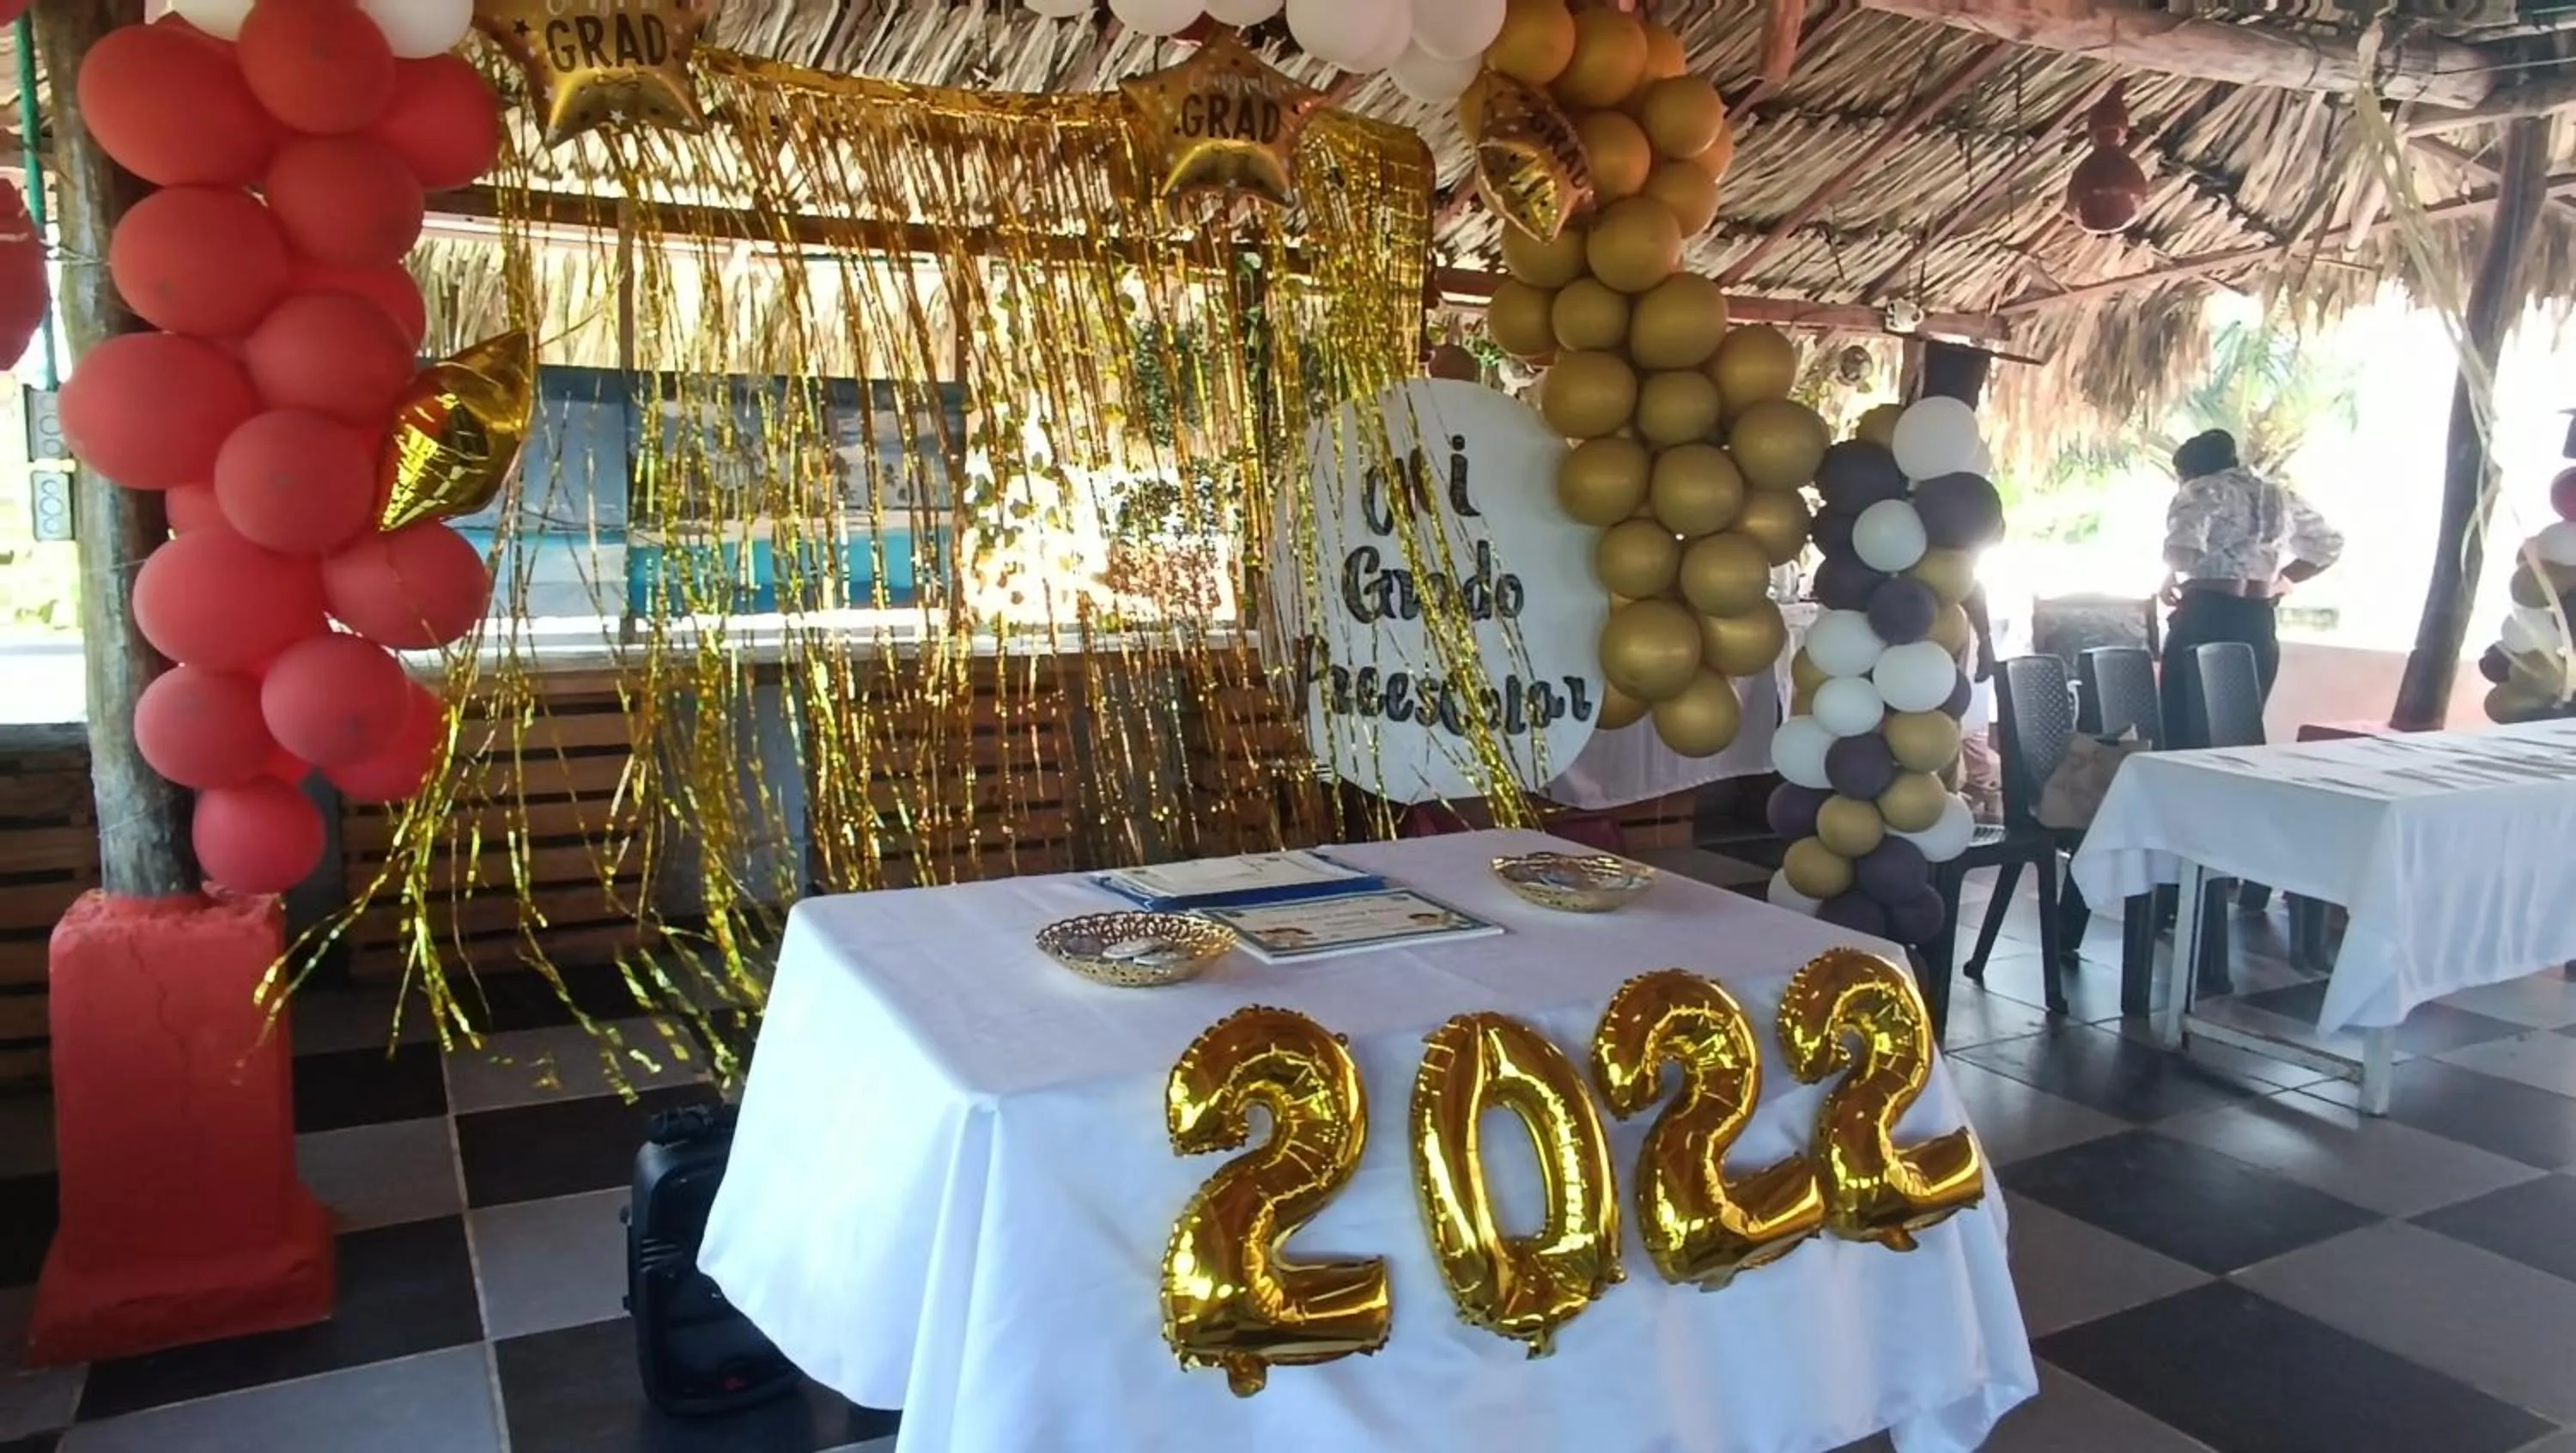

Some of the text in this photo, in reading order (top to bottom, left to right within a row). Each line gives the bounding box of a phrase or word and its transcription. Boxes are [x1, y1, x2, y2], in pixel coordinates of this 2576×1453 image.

[545, 13, 667, 73] GRAD
[1182, 93, 1280, 144] GRAD
[1159, 946, 1985, 1398] 2022
